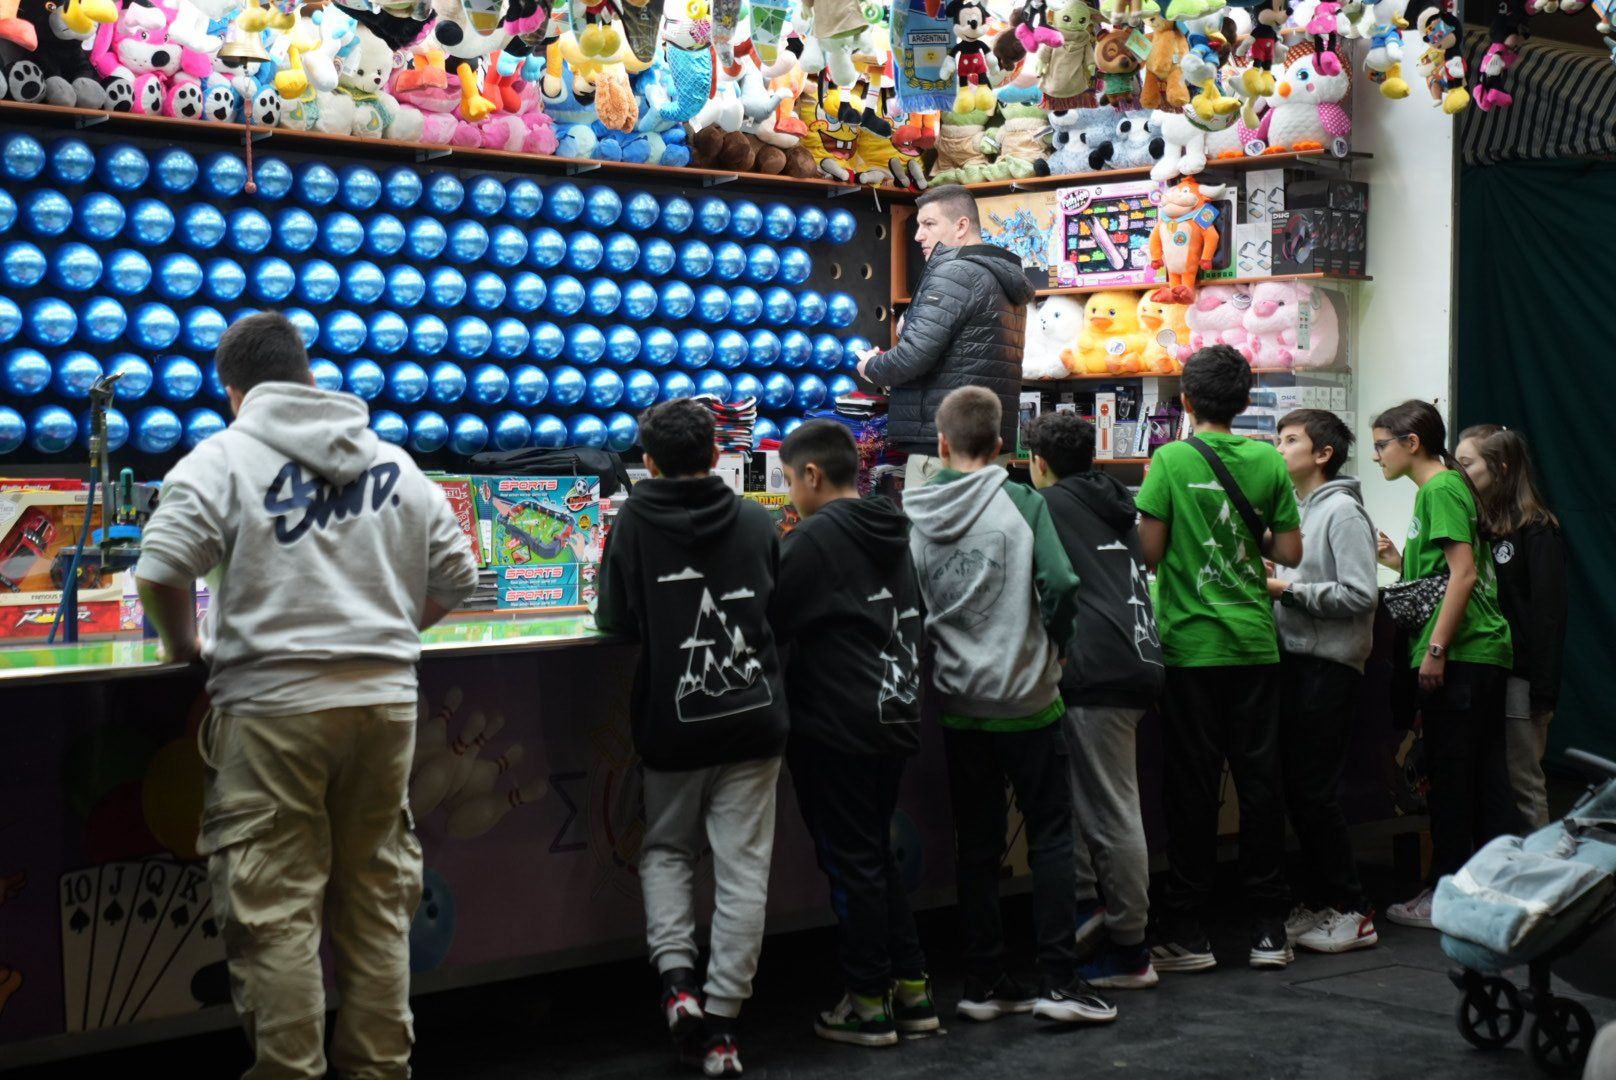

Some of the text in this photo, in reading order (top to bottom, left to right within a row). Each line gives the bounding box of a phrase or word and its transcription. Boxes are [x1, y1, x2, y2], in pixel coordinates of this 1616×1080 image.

[912, 33, 947, 42] ARGENTINA
[499, 480, 558, 491] SPORTS
[758, 496, 785, 506] DINO
[505, 566, 563, 579] SPORTS
[505, 588, 563, 602] SPORTS
[64, 875, 91, 907] 10
[109, 866, 125, 896] J
[146, 865, 165, 898] Q
